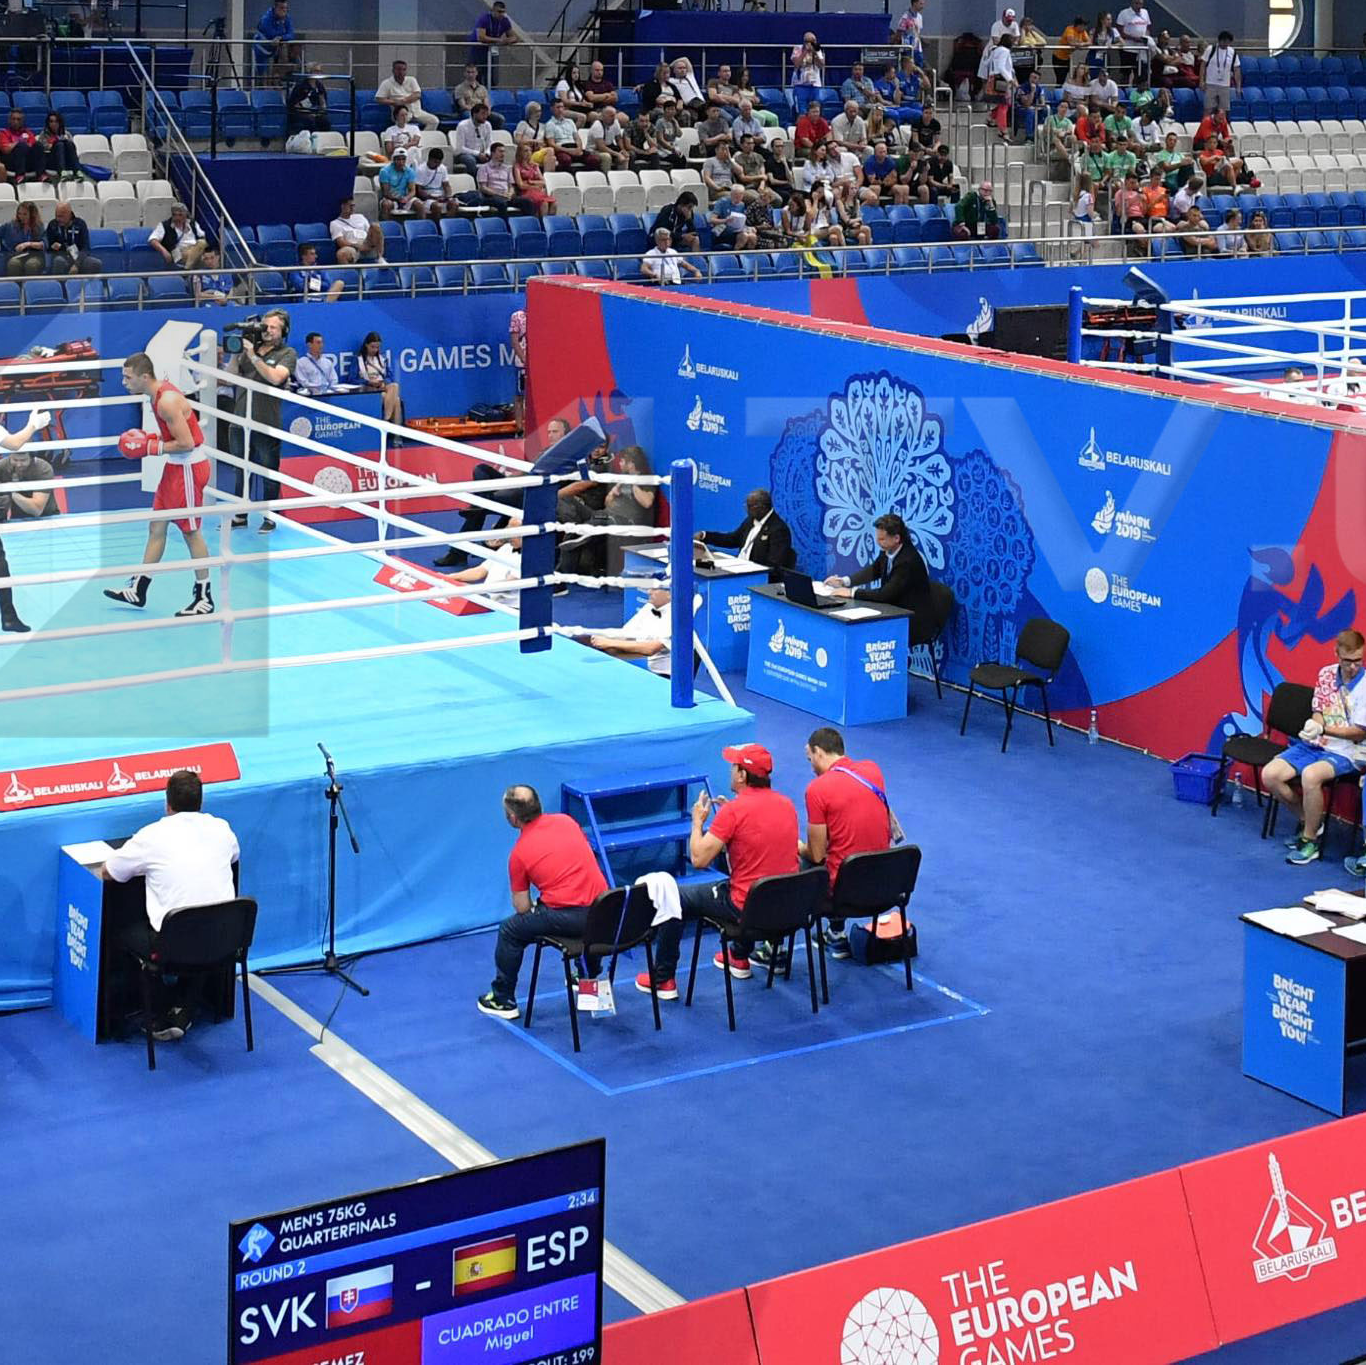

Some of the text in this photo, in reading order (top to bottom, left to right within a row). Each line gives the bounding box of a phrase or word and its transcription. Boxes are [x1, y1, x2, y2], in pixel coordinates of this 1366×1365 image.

[400, 344, 492, 373] GAMES
[315, 422, 361, 433] EUROPEAN
[1106, 451, 1171, 476] BELARUSKALI
[1115, 521, 1142, 541] 2019
[1111, 573, 1128, 586] THE
[1111, 584, 1161, 607] EUROPEAN
[1111, 595, 1142, 613] GAMES
[33, 781, 104, 797] BELARUSKALI
[1272, 973, 1316, 1003] BRIGHT
[1272, 1002, 1314, 1032] BRIGHT
[1279, 1020, 1307, 1045] YOU!
[567, 1190, 596, 1210] 2:34
[279, 1202, 367, 1235] MEN'S 75KG
[279, 1213, 397, 1253] QUARTERFINALS
[526, 1224, 590, 1273] ESP
[1259, 1241, 1333, 1277] BELARUSKALI
[240, 1260, 307, 1289] ROUND 2
[941, 1260, 1009, 1307] THE
[950, 1260, 1139, 1346] EUROPEAN
[239, 1292, 319, 1345] SVK
[438, 1295, 579, 1346] CUADRADO ENTRE
[484, 1324, 535, 1353] Miguel
[959, 1318, 1076, 1365] GAMES
[571, 1347, 596, 1365] 199
